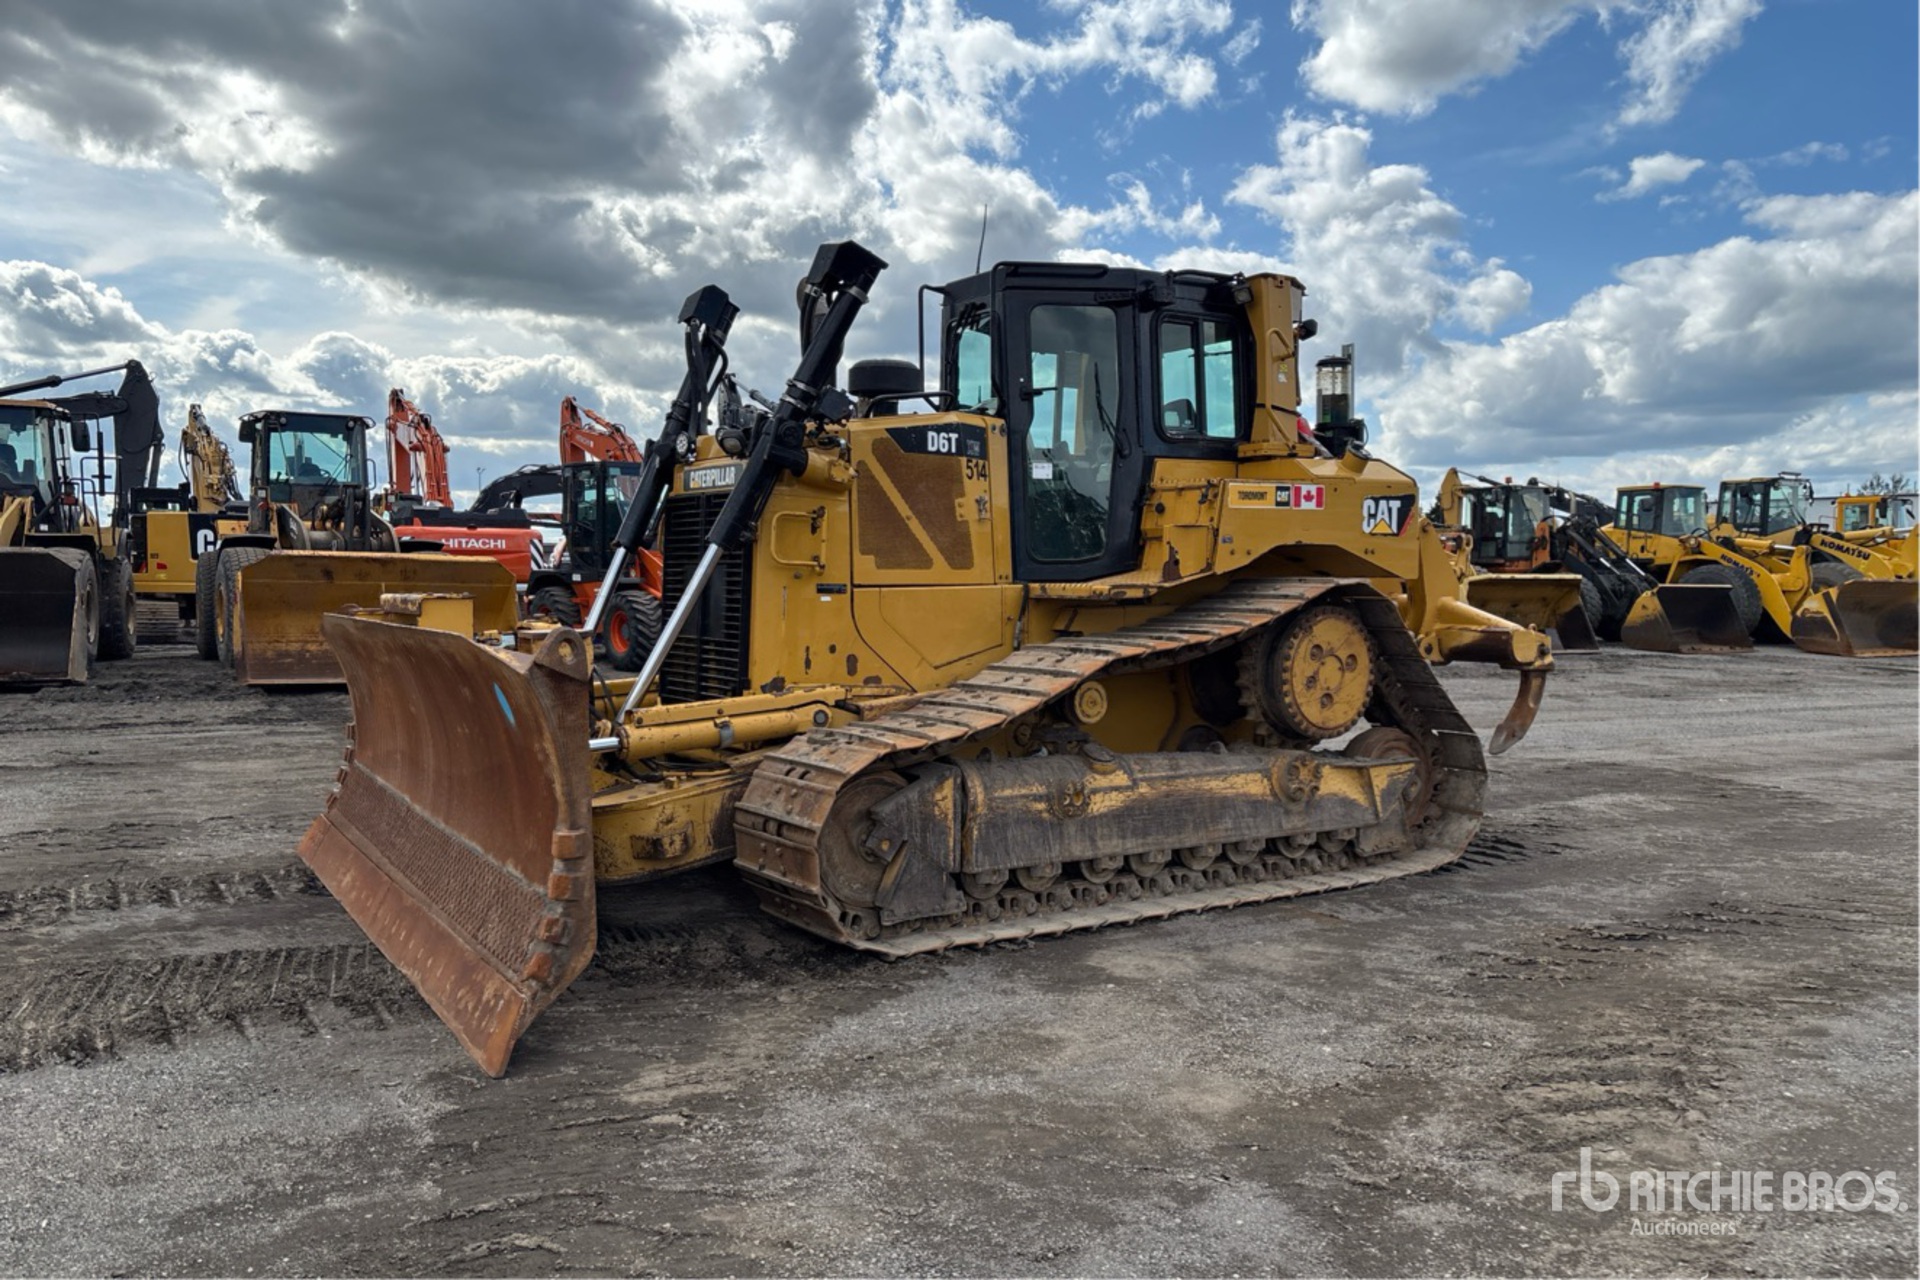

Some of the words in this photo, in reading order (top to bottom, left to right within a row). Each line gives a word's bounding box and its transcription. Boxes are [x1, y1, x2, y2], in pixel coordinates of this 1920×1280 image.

[927, 431, 959, 453] D6T
[690, 466, 735, 488] CATERPILLAR
[966, 458, 988, 482] 514
[1362, 499, 1401, 534] CAT
[441, 538, 506, 549] HITACHI
[1820, 539, 1871, 561] KOMATSU
